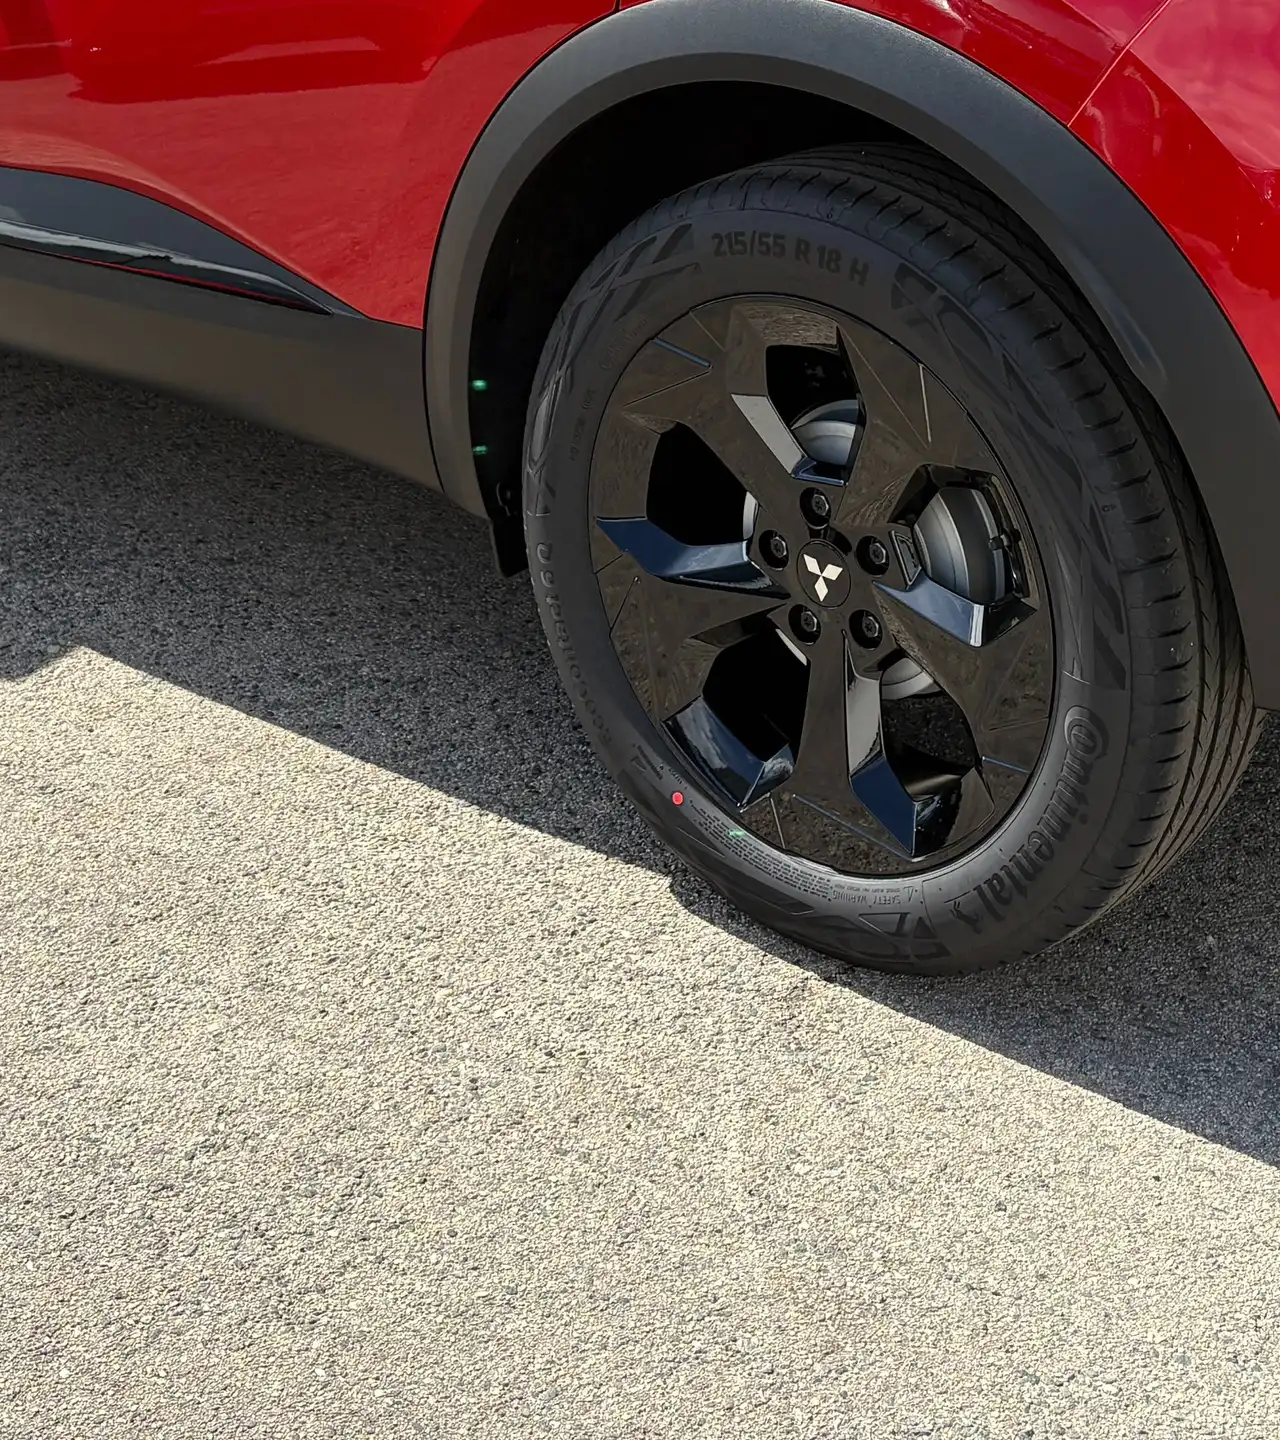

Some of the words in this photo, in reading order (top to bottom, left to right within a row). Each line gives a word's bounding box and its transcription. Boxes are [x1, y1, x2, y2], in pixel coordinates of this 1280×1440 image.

[711, 230, 786, 258] 215/55
[794, 236, 811, 265] R
[817, 244, 842, 274] 18
[848, 257, 870, 286] H
[972, 705, 1110, 924] Continental
